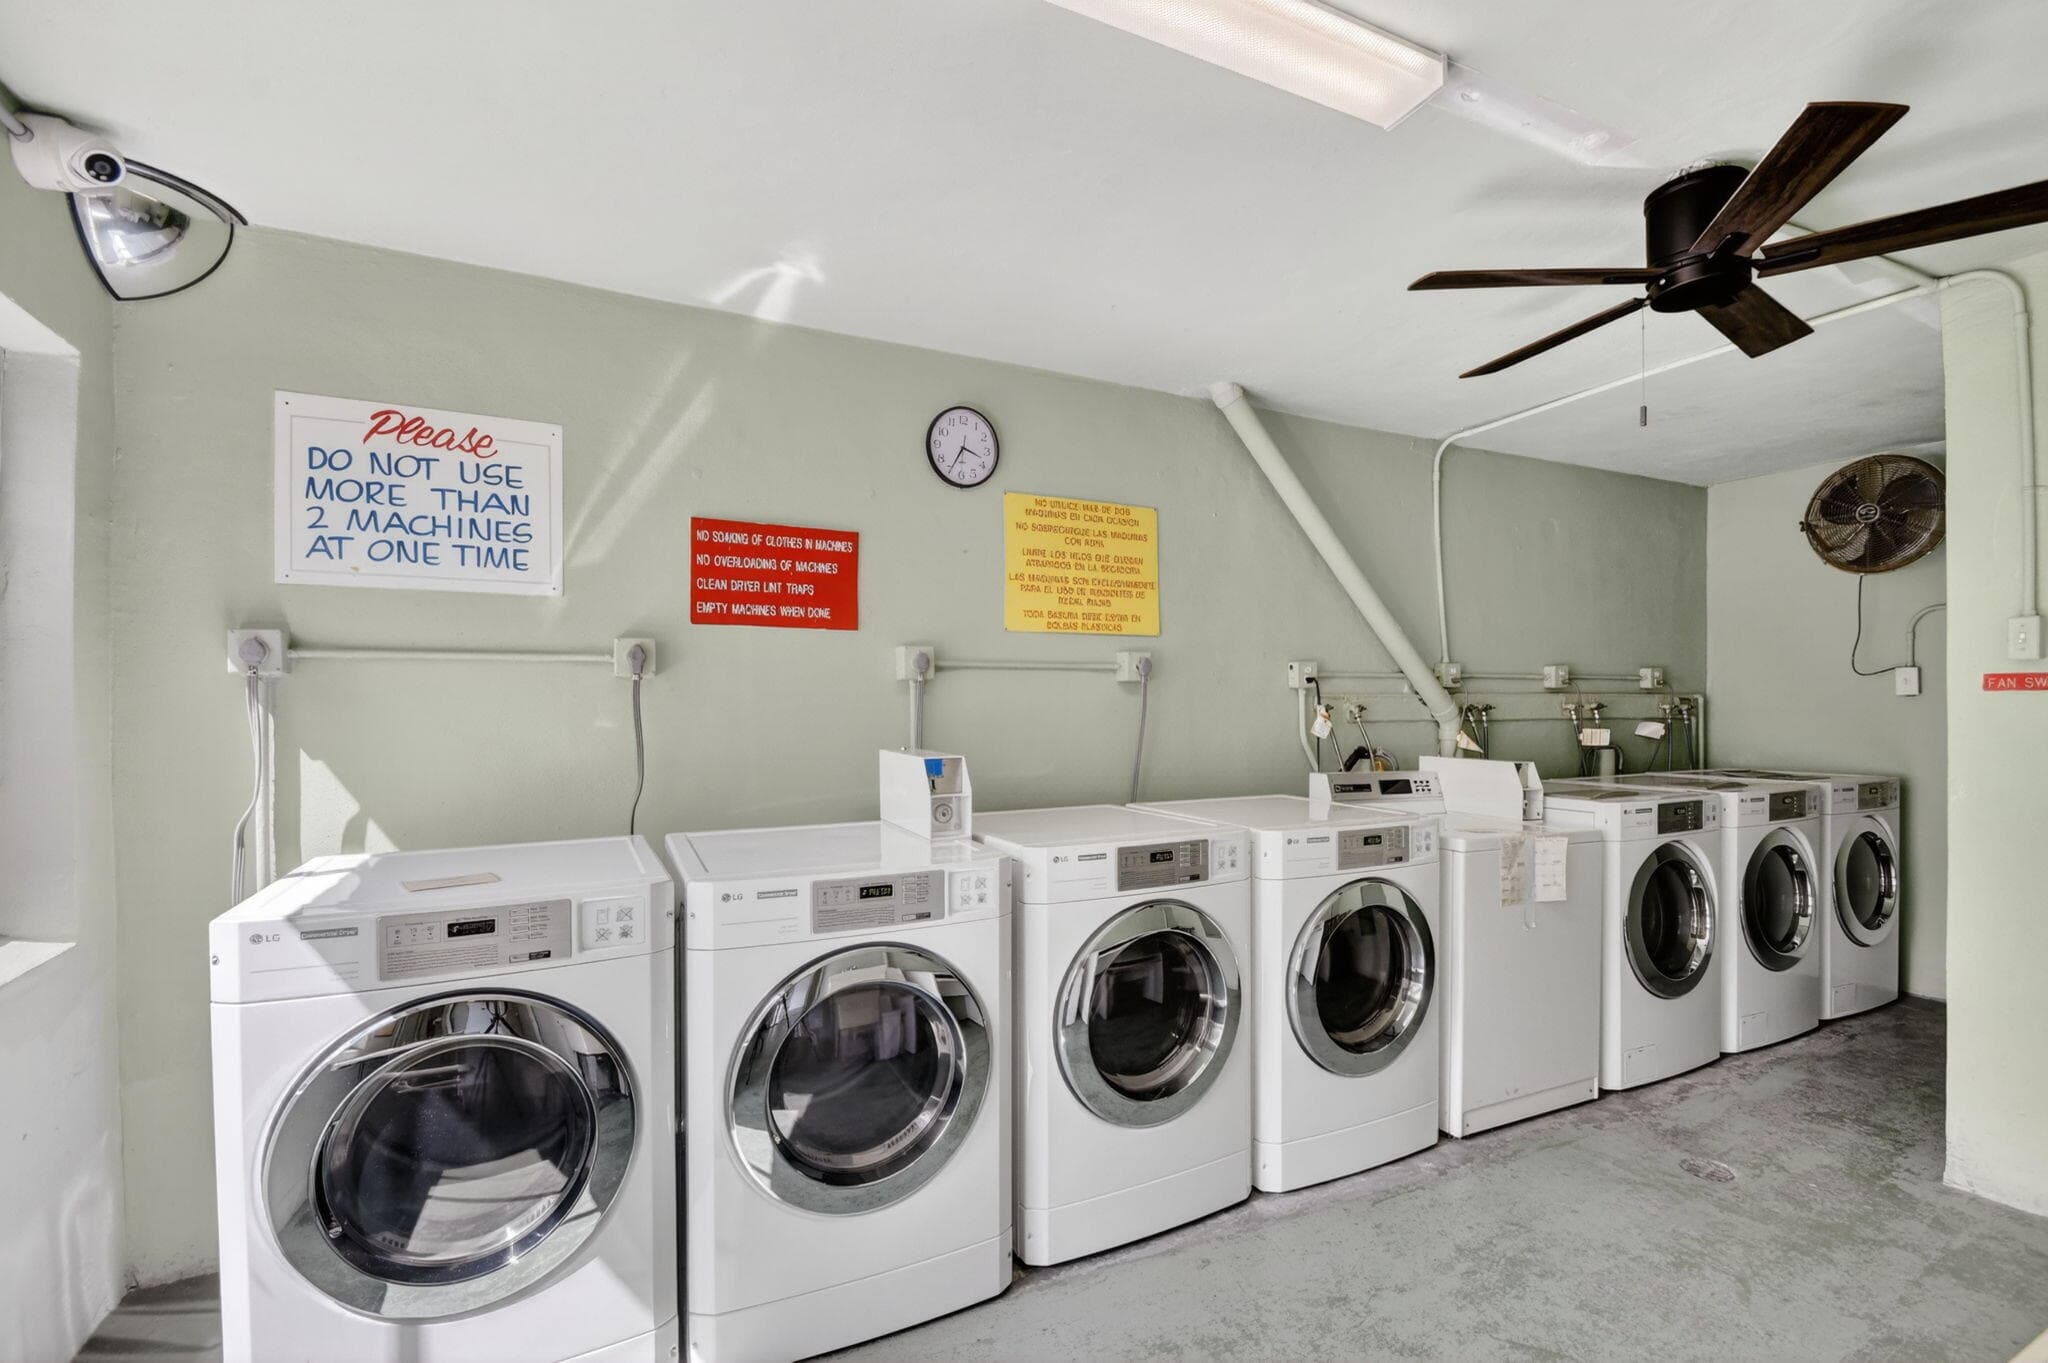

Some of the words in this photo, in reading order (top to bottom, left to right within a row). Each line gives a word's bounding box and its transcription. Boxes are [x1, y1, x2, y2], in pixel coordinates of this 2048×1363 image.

[960, 416, 968, 425] 12
[363, 409, 498, 458] Please
[939, 427, 948, 436] 10
[981, 433, 987, 442] 2
[934, 440, 941, 448] 9
[984, 448, 990, 456] 3
[308, 447, 352, 471] DO
[370, 452, 439, 480] NOT
[459, 461, 524, 488] USE
[305, 477, 407, 507] MORE
[430, 488, 529, 516] THAN
[306, 506, 329, 529] 2
[346, 509, 532, 543] MACHINES
[697, 530, 709, 541] NO
[712, 531, 749, 544] SOAKING
[752, 535, 763, 545] OF
[766, 536, 802, 548] CLOTHES
[805, 538, 813, 549] IN
[815, 540, 852, 552] MACHINES
[305, 535, 354, 559] AT
[367, 539, 441, 565] ONE
[451, 544, 529, 571] TIME
[697, 555, 710, 565] NO
[714, 555, 777, 569] OVERLOADING
[780, 560, 792, 571] OF
[796, 561, 838, 574] MACHINES
[697, 578, 727, 590] CLEAN
[731, 581, 760, 592] DRYER
[764, 582, 782, 593] LINT
[786, 583, 814, 595] TRAPS
[696, 602, 728, 613] EMPTY
[732, 604, 776, 616] MACHINES
[780, 606, 804, 617] WHEN
[808, 607, 831, 619] DONE
[1988, 678, 2016, 688] FAN
[731, 893, 744, 902] LG
[265, 933, 281, 943] LG
